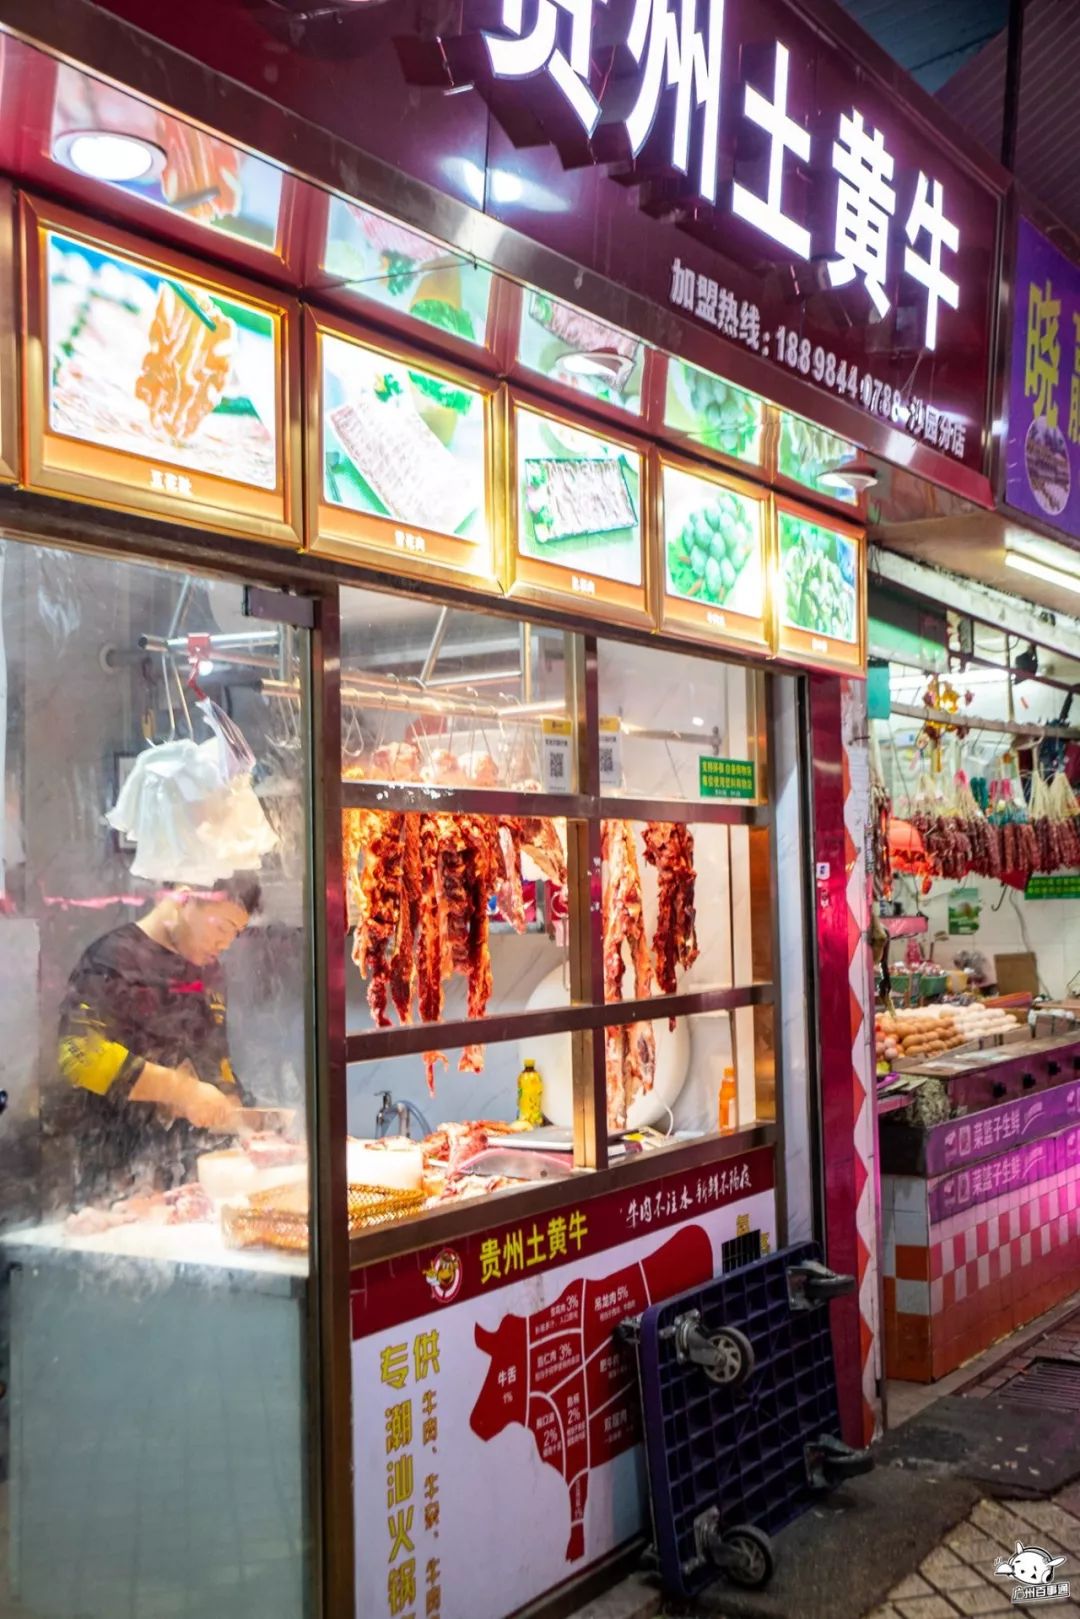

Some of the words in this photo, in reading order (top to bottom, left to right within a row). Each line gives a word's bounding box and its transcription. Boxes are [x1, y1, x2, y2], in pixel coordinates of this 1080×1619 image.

[626, 1185, 693, 1229] 牛肉不注水
[479, 1210, 588, 1285] 贵州土黄牛
[380, 1328, 440, 1390] 专供
[498, 1365, 517, 1388] 牛舌
[384, 1398, 417, 1619] 潮汕火锅
